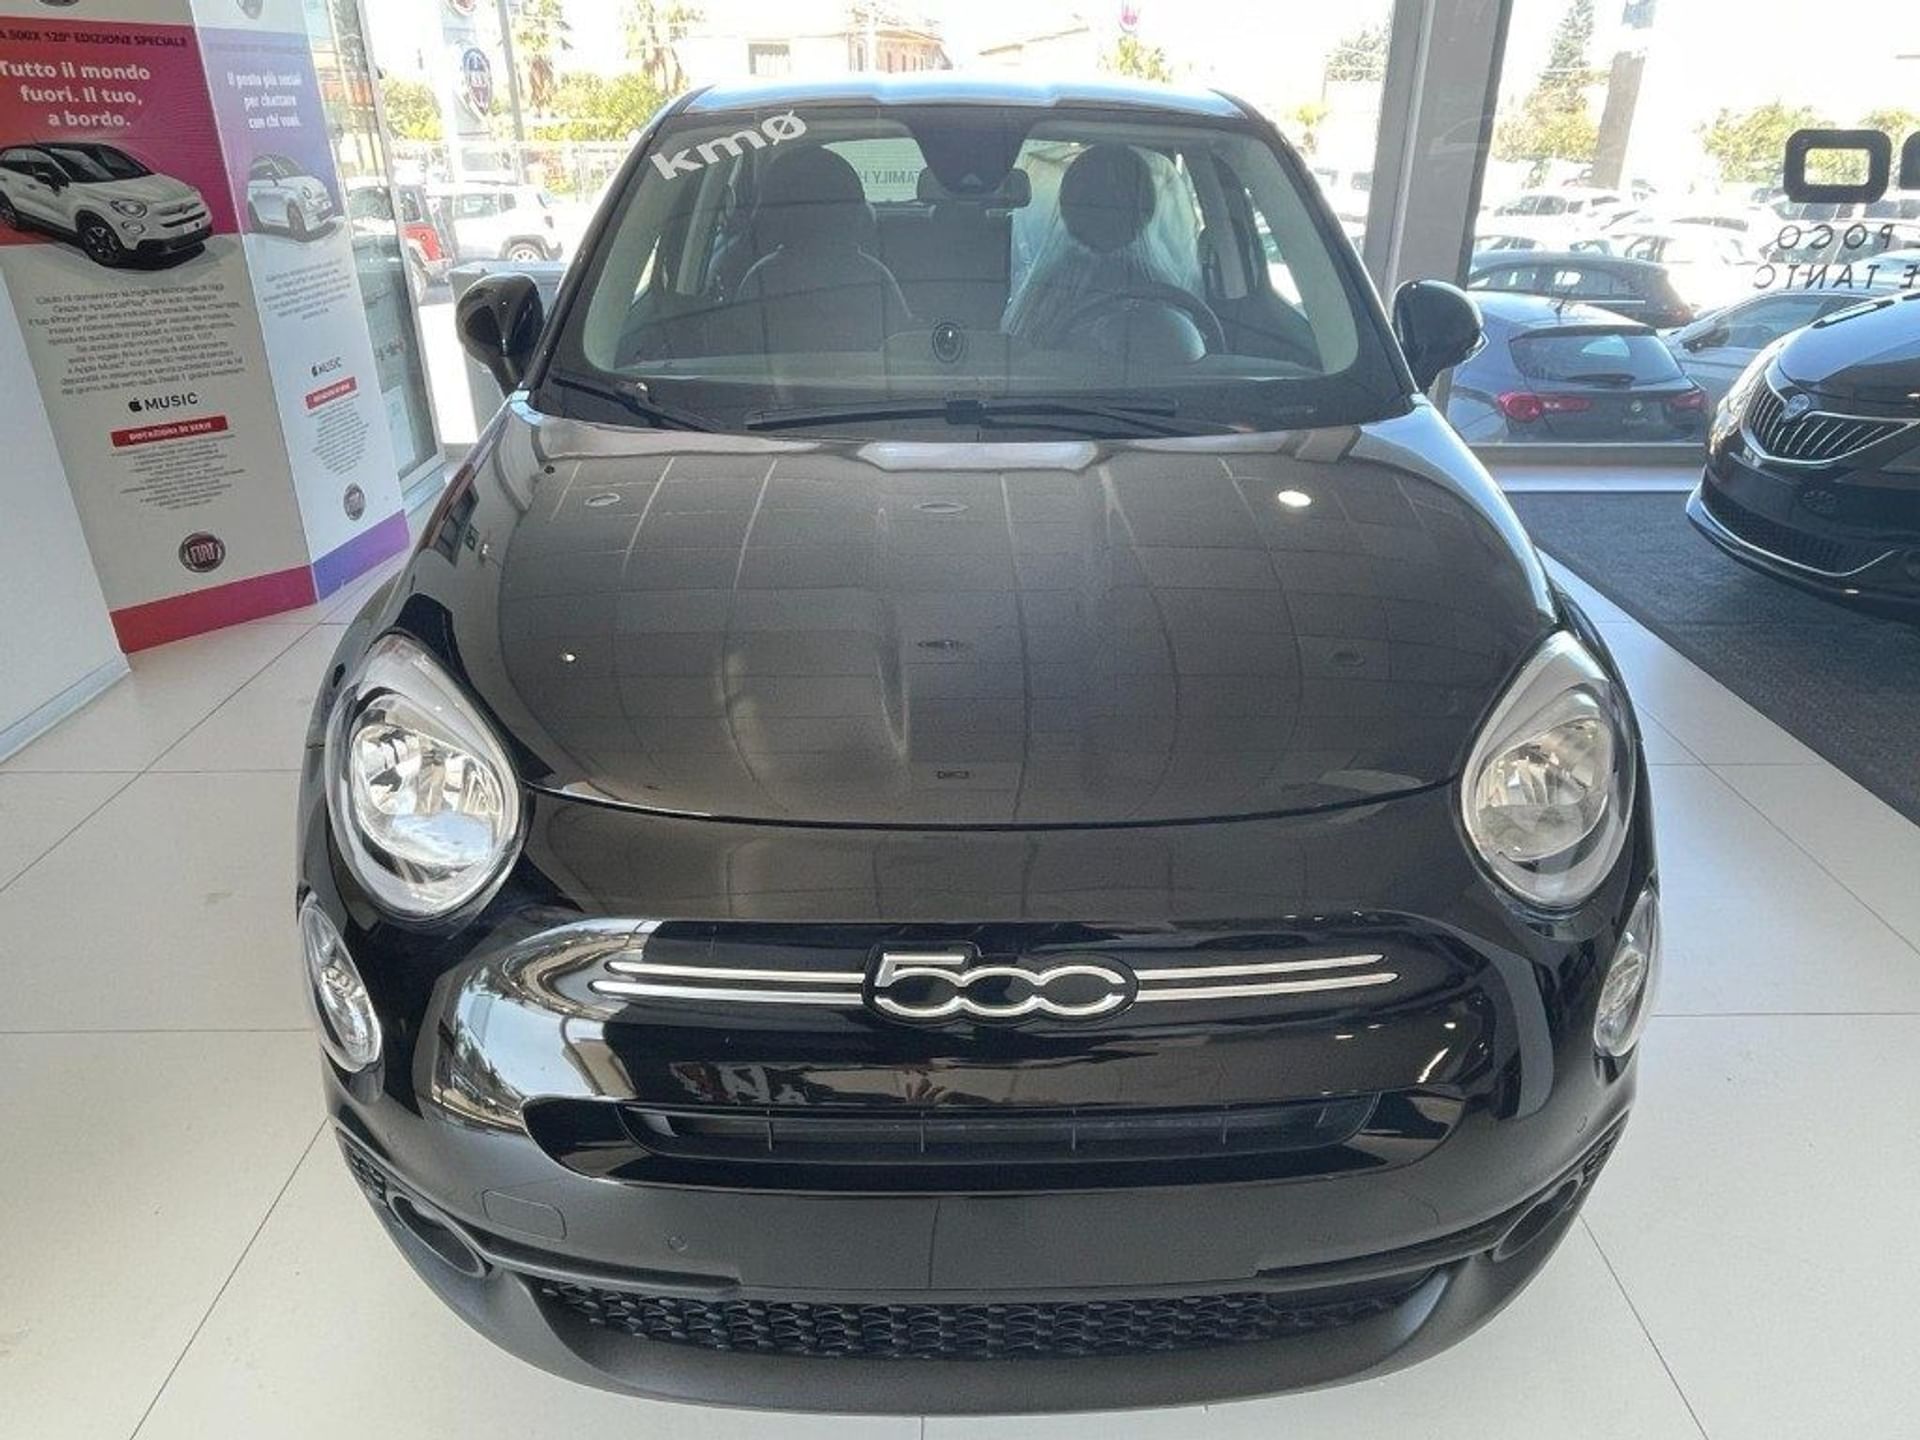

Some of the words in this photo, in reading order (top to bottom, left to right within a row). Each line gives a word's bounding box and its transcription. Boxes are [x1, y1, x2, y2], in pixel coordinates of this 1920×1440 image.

[0, 61, 57, 78] Tutto
[61, 62, 76, 78] il
[81, 64, 151, 80] mondo
[20, 84, 80, 102] fuori.
[102, 88, 143, 105] tuo,
[48, 113, 61, 126] a
[64, 110, 132, 127] bordo.
[145, 392, 199, 411] MUSIC
[874, 952, 1127, 1018] 500
